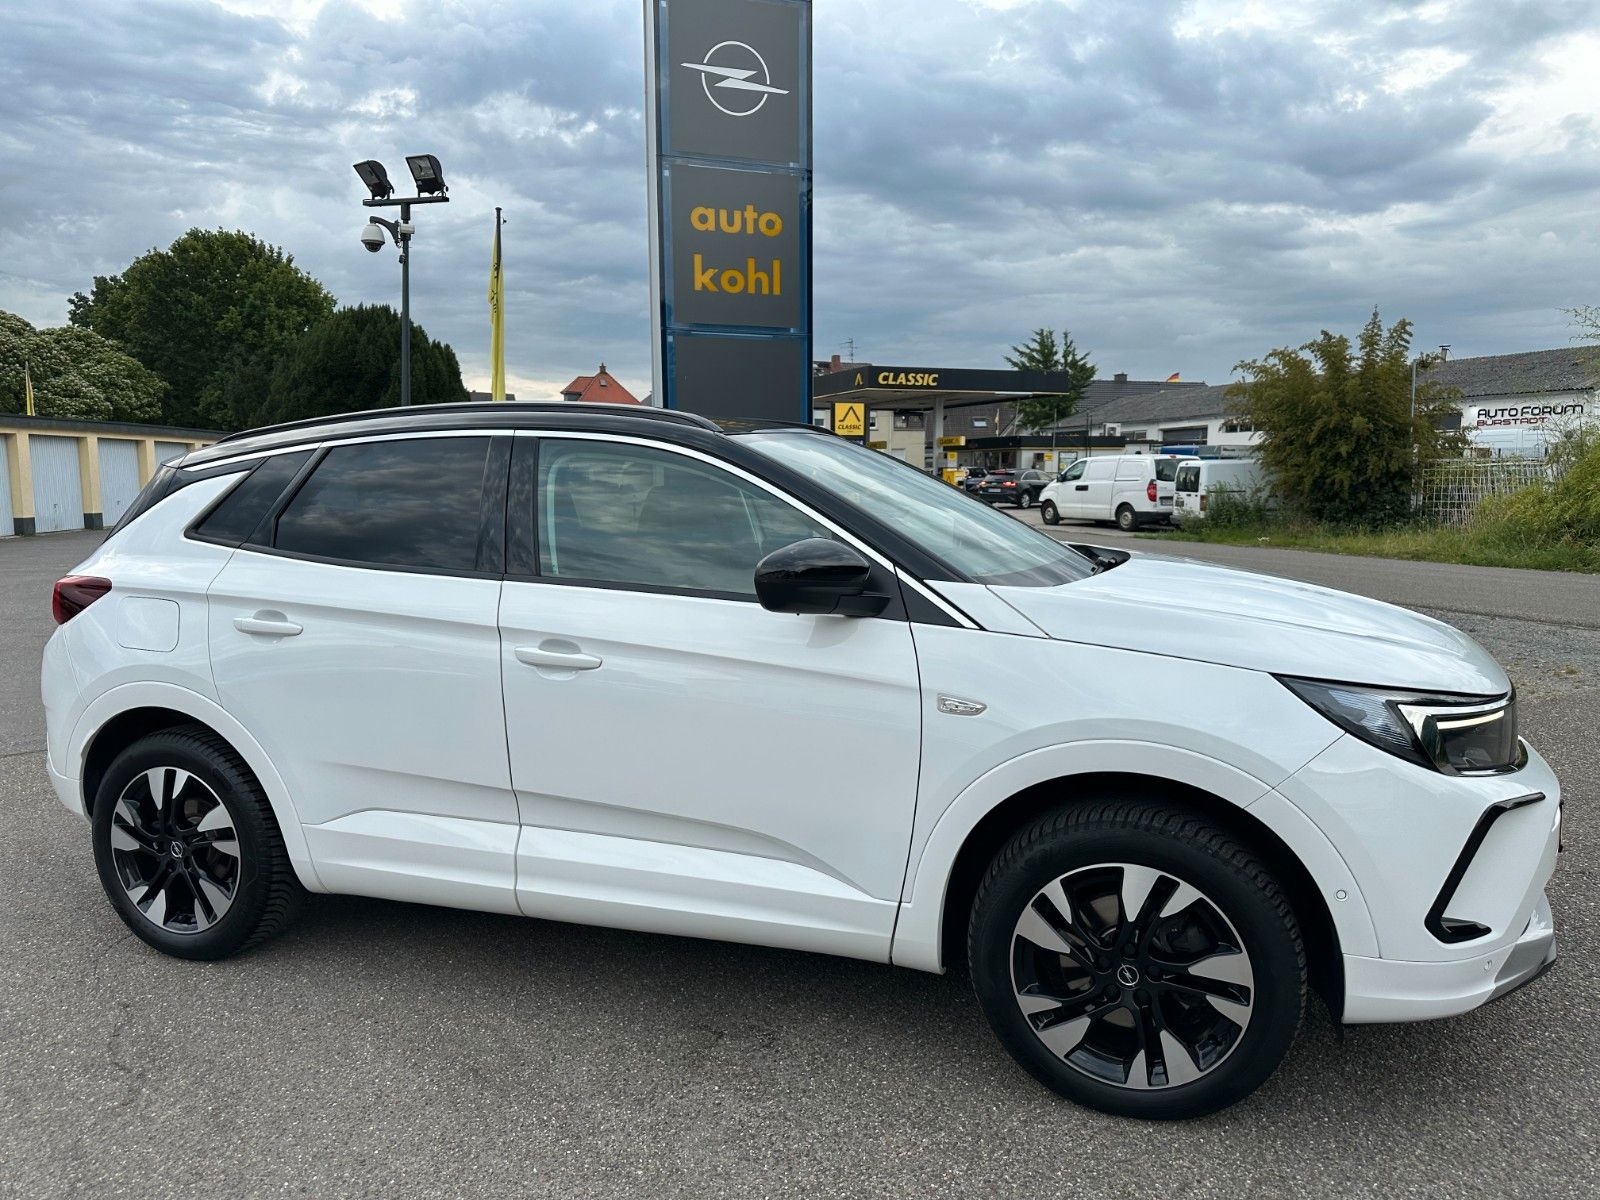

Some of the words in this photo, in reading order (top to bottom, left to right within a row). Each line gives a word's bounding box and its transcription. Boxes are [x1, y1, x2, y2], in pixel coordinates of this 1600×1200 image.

[690, 204, 783, 237] auto
[692, 253, 782, 296] kohl
[877, 371, 939, 386] CLASSIC
[1477, 407, 1519, 419] AUTO
[1520, 404, 1584, 417] FORUM
